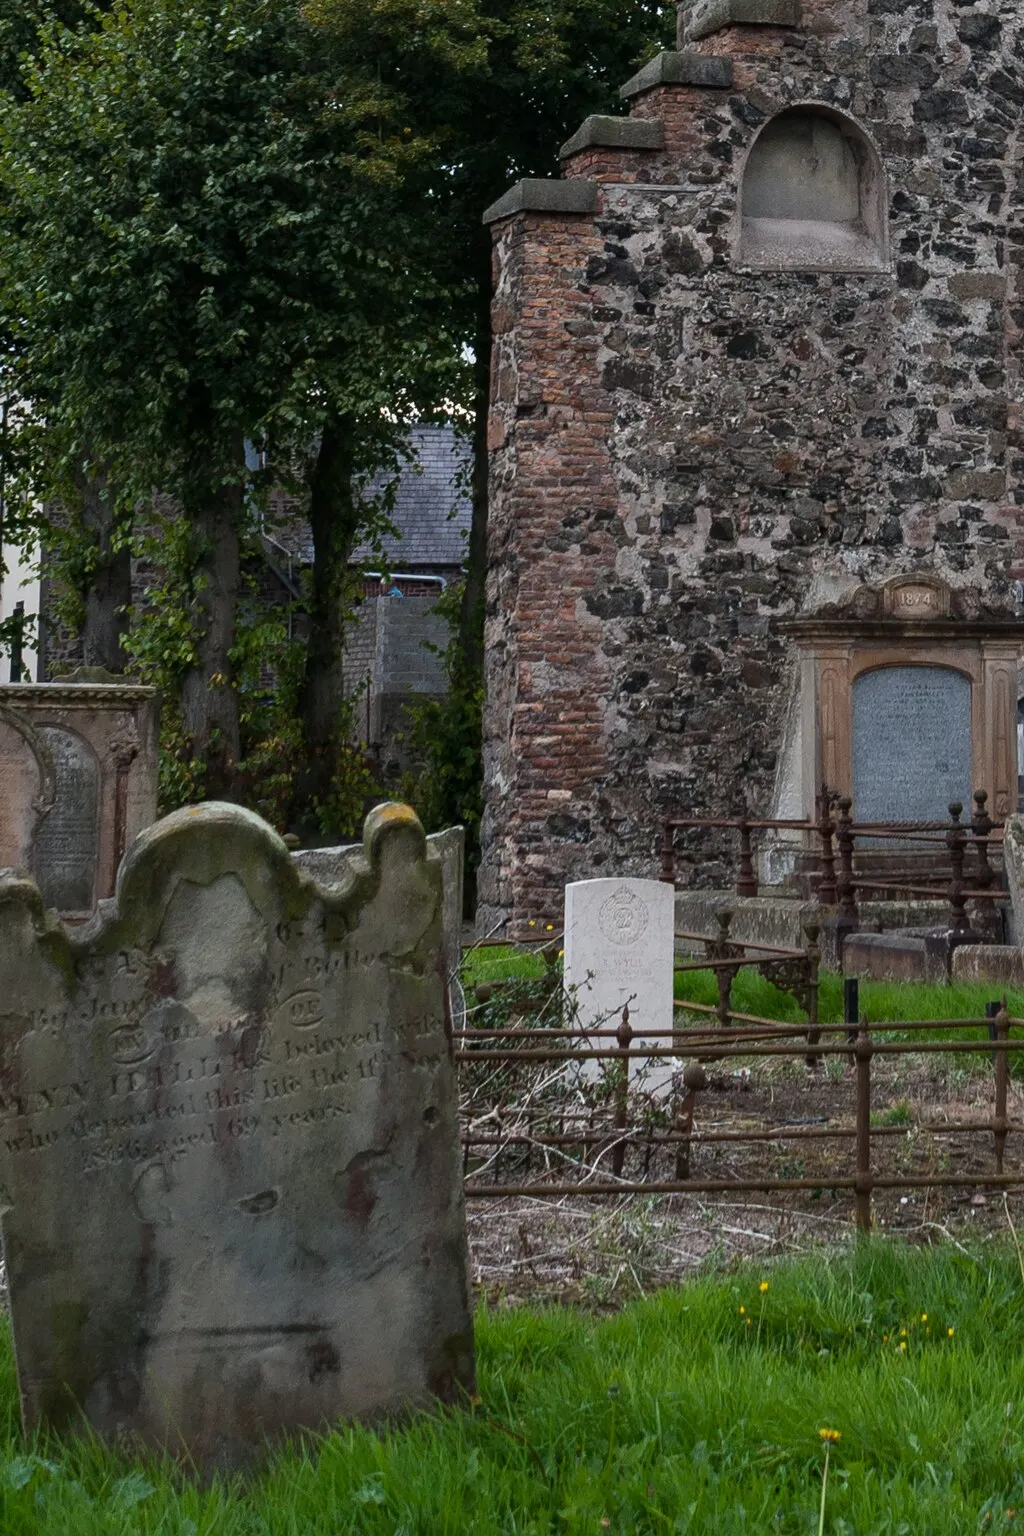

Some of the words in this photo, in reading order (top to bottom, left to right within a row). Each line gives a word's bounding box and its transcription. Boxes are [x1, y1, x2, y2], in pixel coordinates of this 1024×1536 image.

[900, 591, 931, 606] 1874
[289, 998, 323, 1020] OF
[283, 1022, 385, 1063] beloved
[4, 1128, 60, 1154] who
[70, 1101, 195, 1144] departed
[204, 1084, 256, 1115] this
[263, 1076, 302, 1102] life
[311, 1064, 348, 1089] the
[226, 1112, 260, 1139] 69
